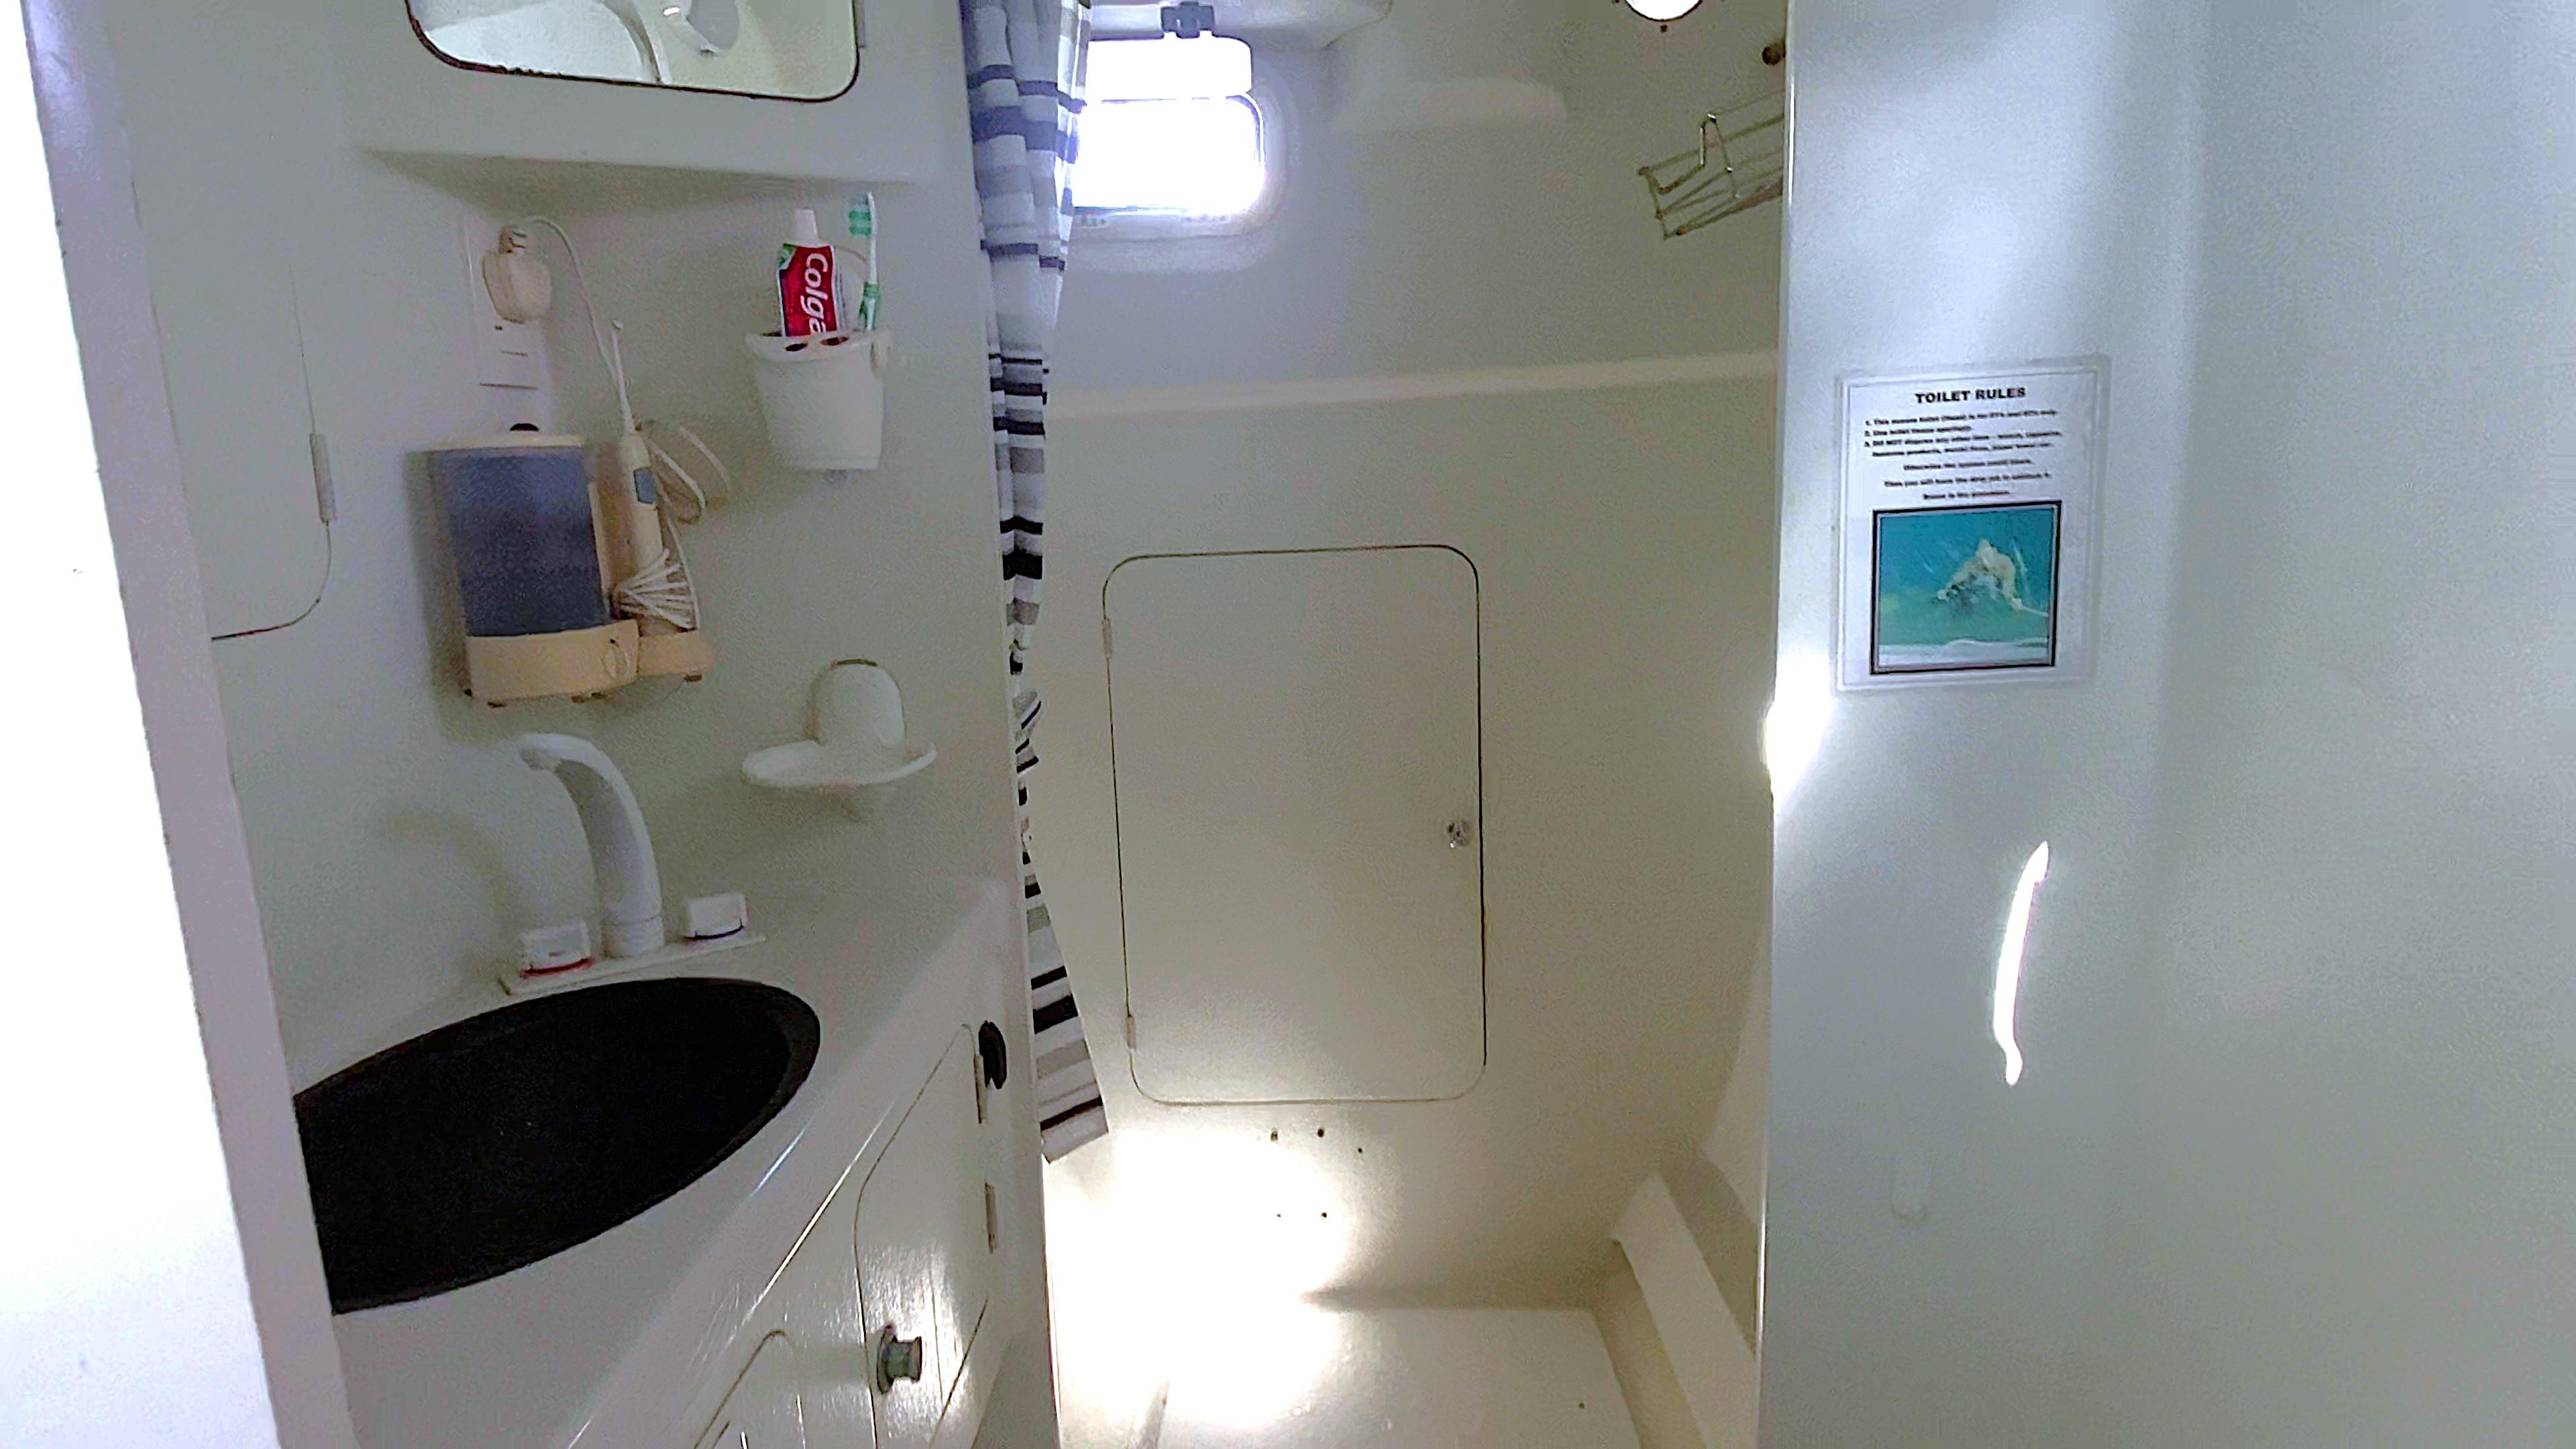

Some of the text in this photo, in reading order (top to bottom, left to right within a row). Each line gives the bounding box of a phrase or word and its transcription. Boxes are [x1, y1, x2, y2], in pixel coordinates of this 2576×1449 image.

[800, 253, 829, 334] Colga
[1915, 387, 2025, 403] TOILET RULES
